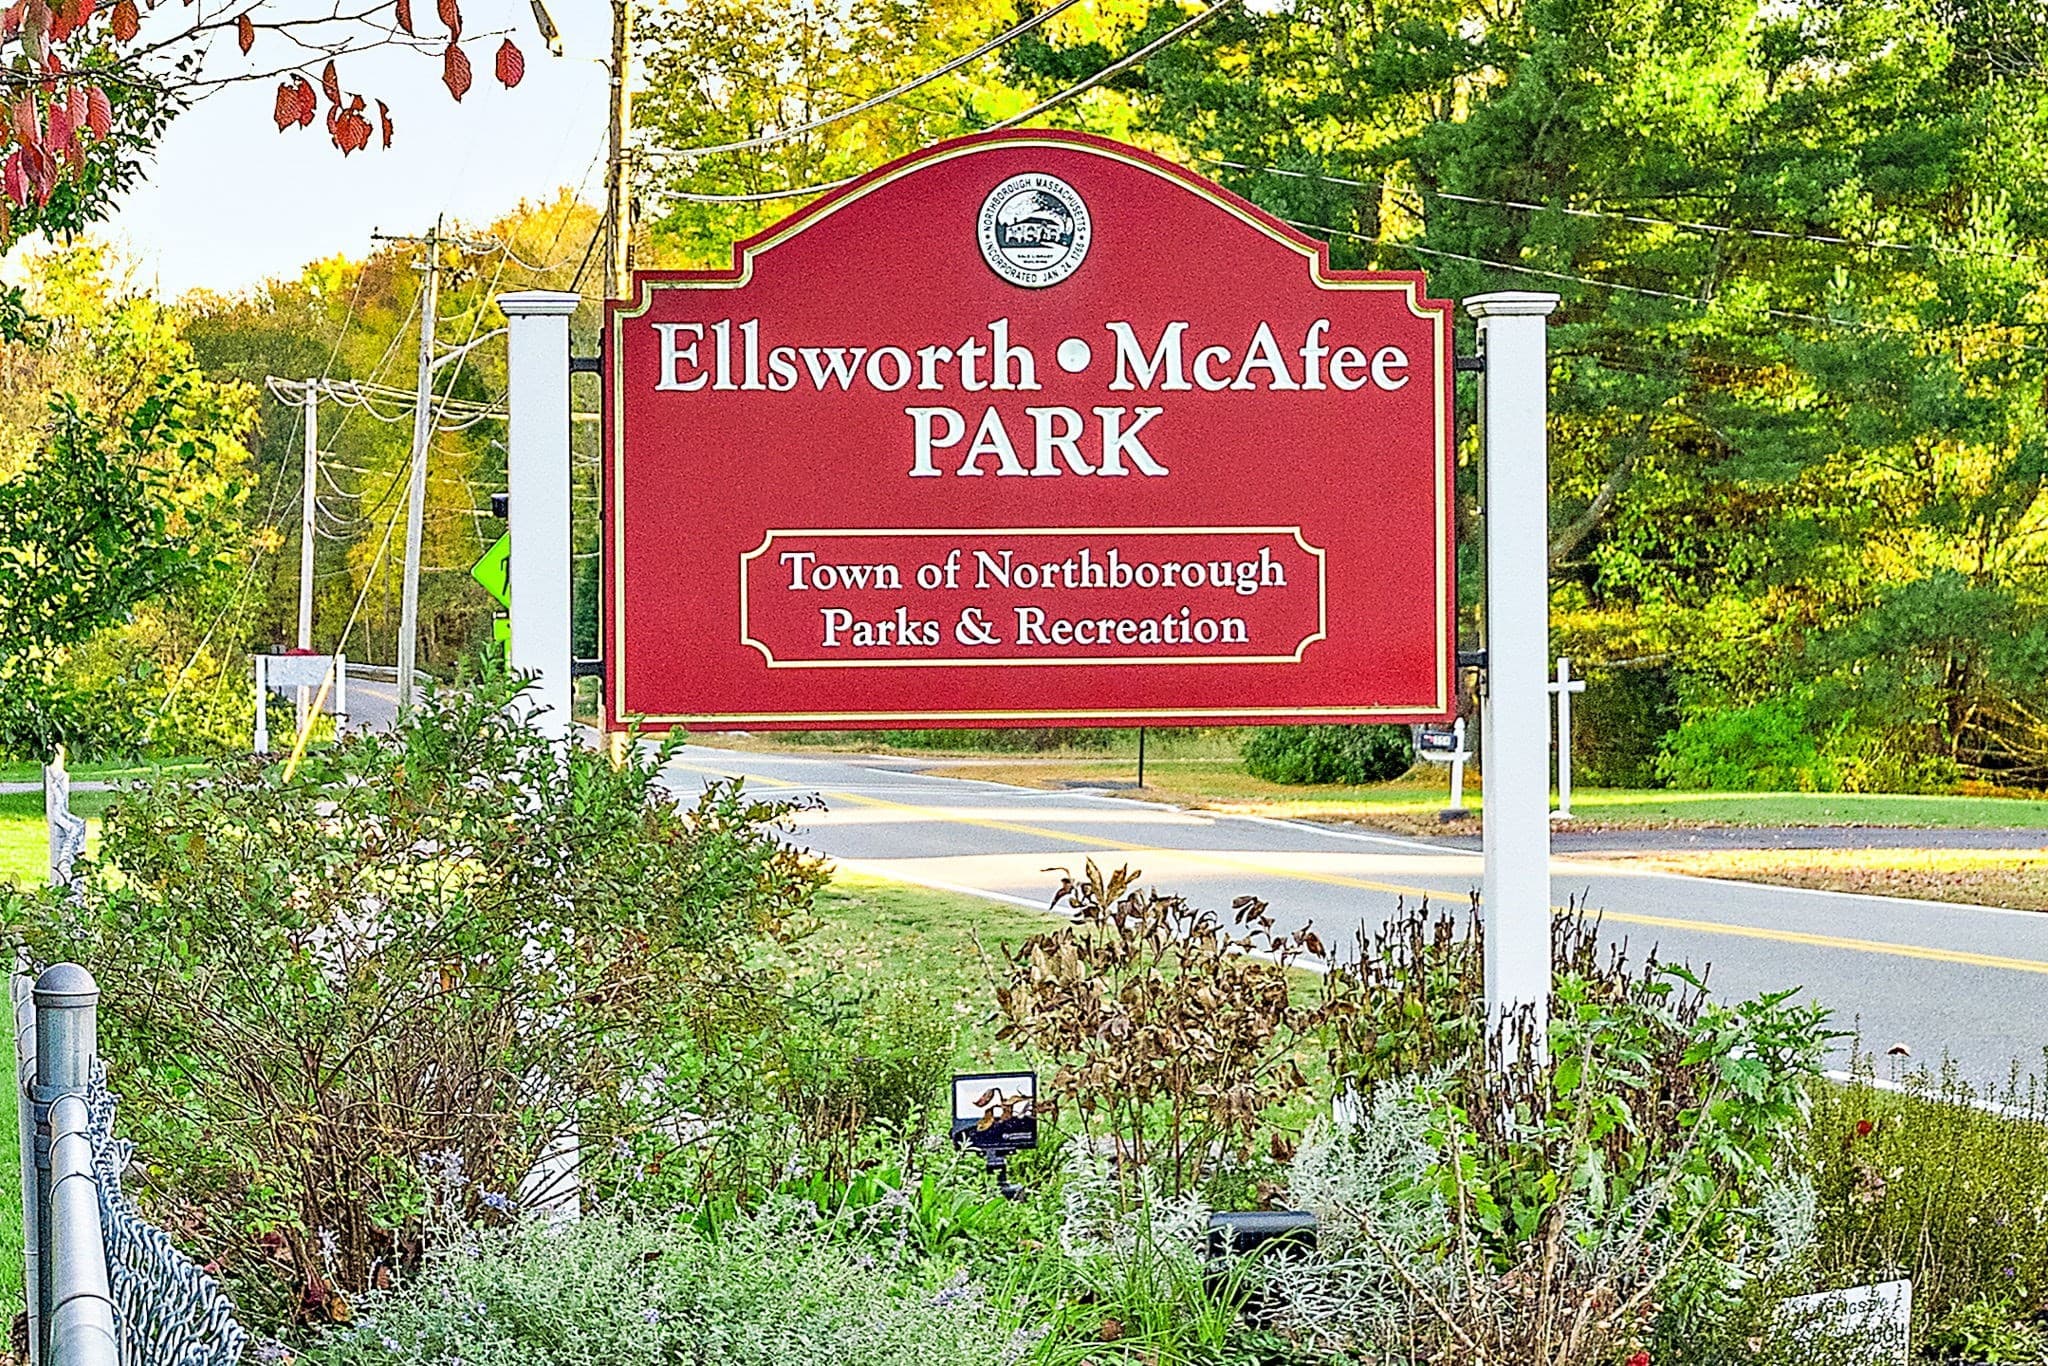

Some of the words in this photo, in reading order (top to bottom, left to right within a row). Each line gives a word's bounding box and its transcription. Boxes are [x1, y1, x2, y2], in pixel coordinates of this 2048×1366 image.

[983, 178, 1032, 232] NORTHBOROUGH
[1035, 178, 1086, 233] MASSACHUSETTS
[984, 240, 1038, 283] INCORPORATED
[651, 319, 1042, 392] Ellsworth
[1105, 319, 1410, 392] McAfee
[904, 406, 1170, 478] PARK
[780, 551, 902, 590] Town
[917, 549, 961, 590] of
[973, 547, 1288, 595] Northborough
[820, 606, 940, 648] Parks
[955, 607, 1002, 646] &
[1014, 605, 1250, 645] Recreation
